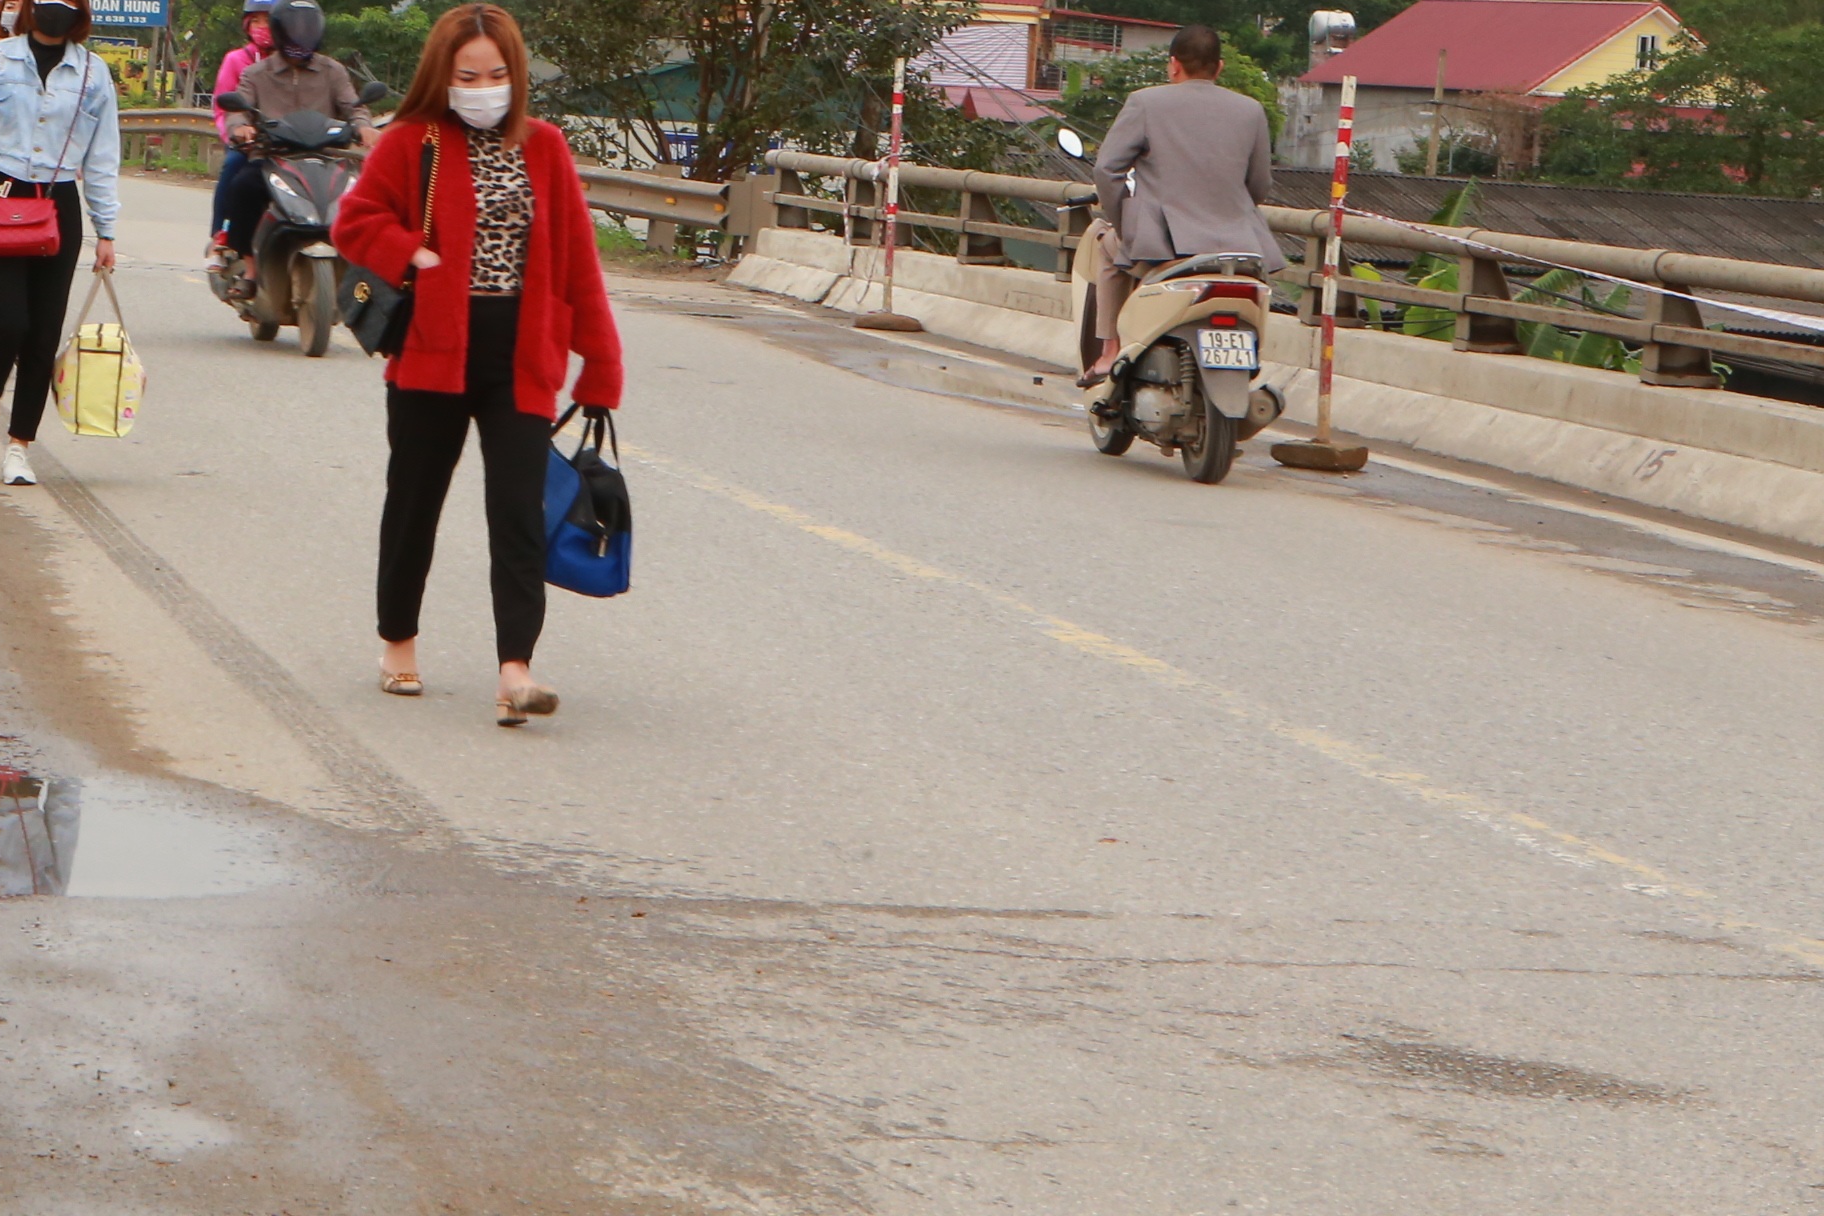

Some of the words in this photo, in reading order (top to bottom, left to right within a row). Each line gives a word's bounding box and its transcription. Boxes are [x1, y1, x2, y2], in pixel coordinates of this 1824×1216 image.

[105, 15, 125, 23] 638
[128, 15, 147, 23] 133
[1208, 332, 1245, 349] 19-E1
[1204, 349, 1253, 366] 267.41
